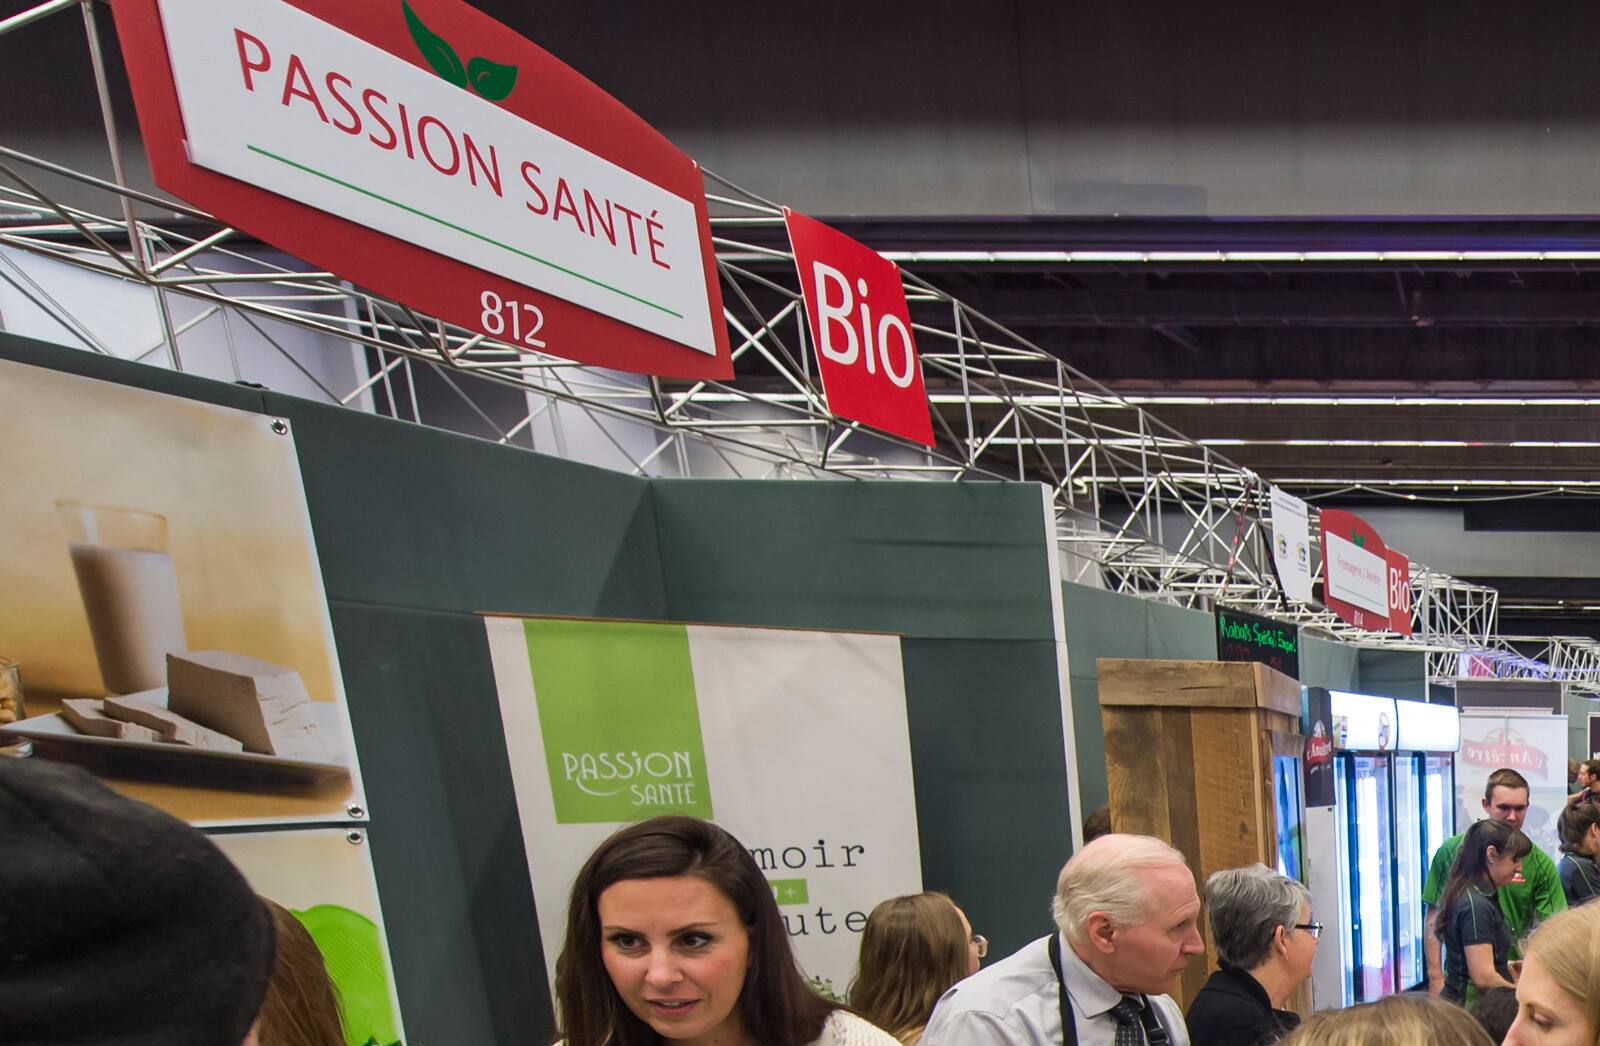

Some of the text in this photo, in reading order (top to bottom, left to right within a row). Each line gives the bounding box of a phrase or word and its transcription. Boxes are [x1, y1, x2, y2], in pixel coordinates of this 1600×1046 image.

[233, 27, 672, 271] PASSION SANTÉ
[480, 290, 546, 349] 812
[813, 261, 915, 388] Bio
[1390, 567, 1411, 614] Bio
